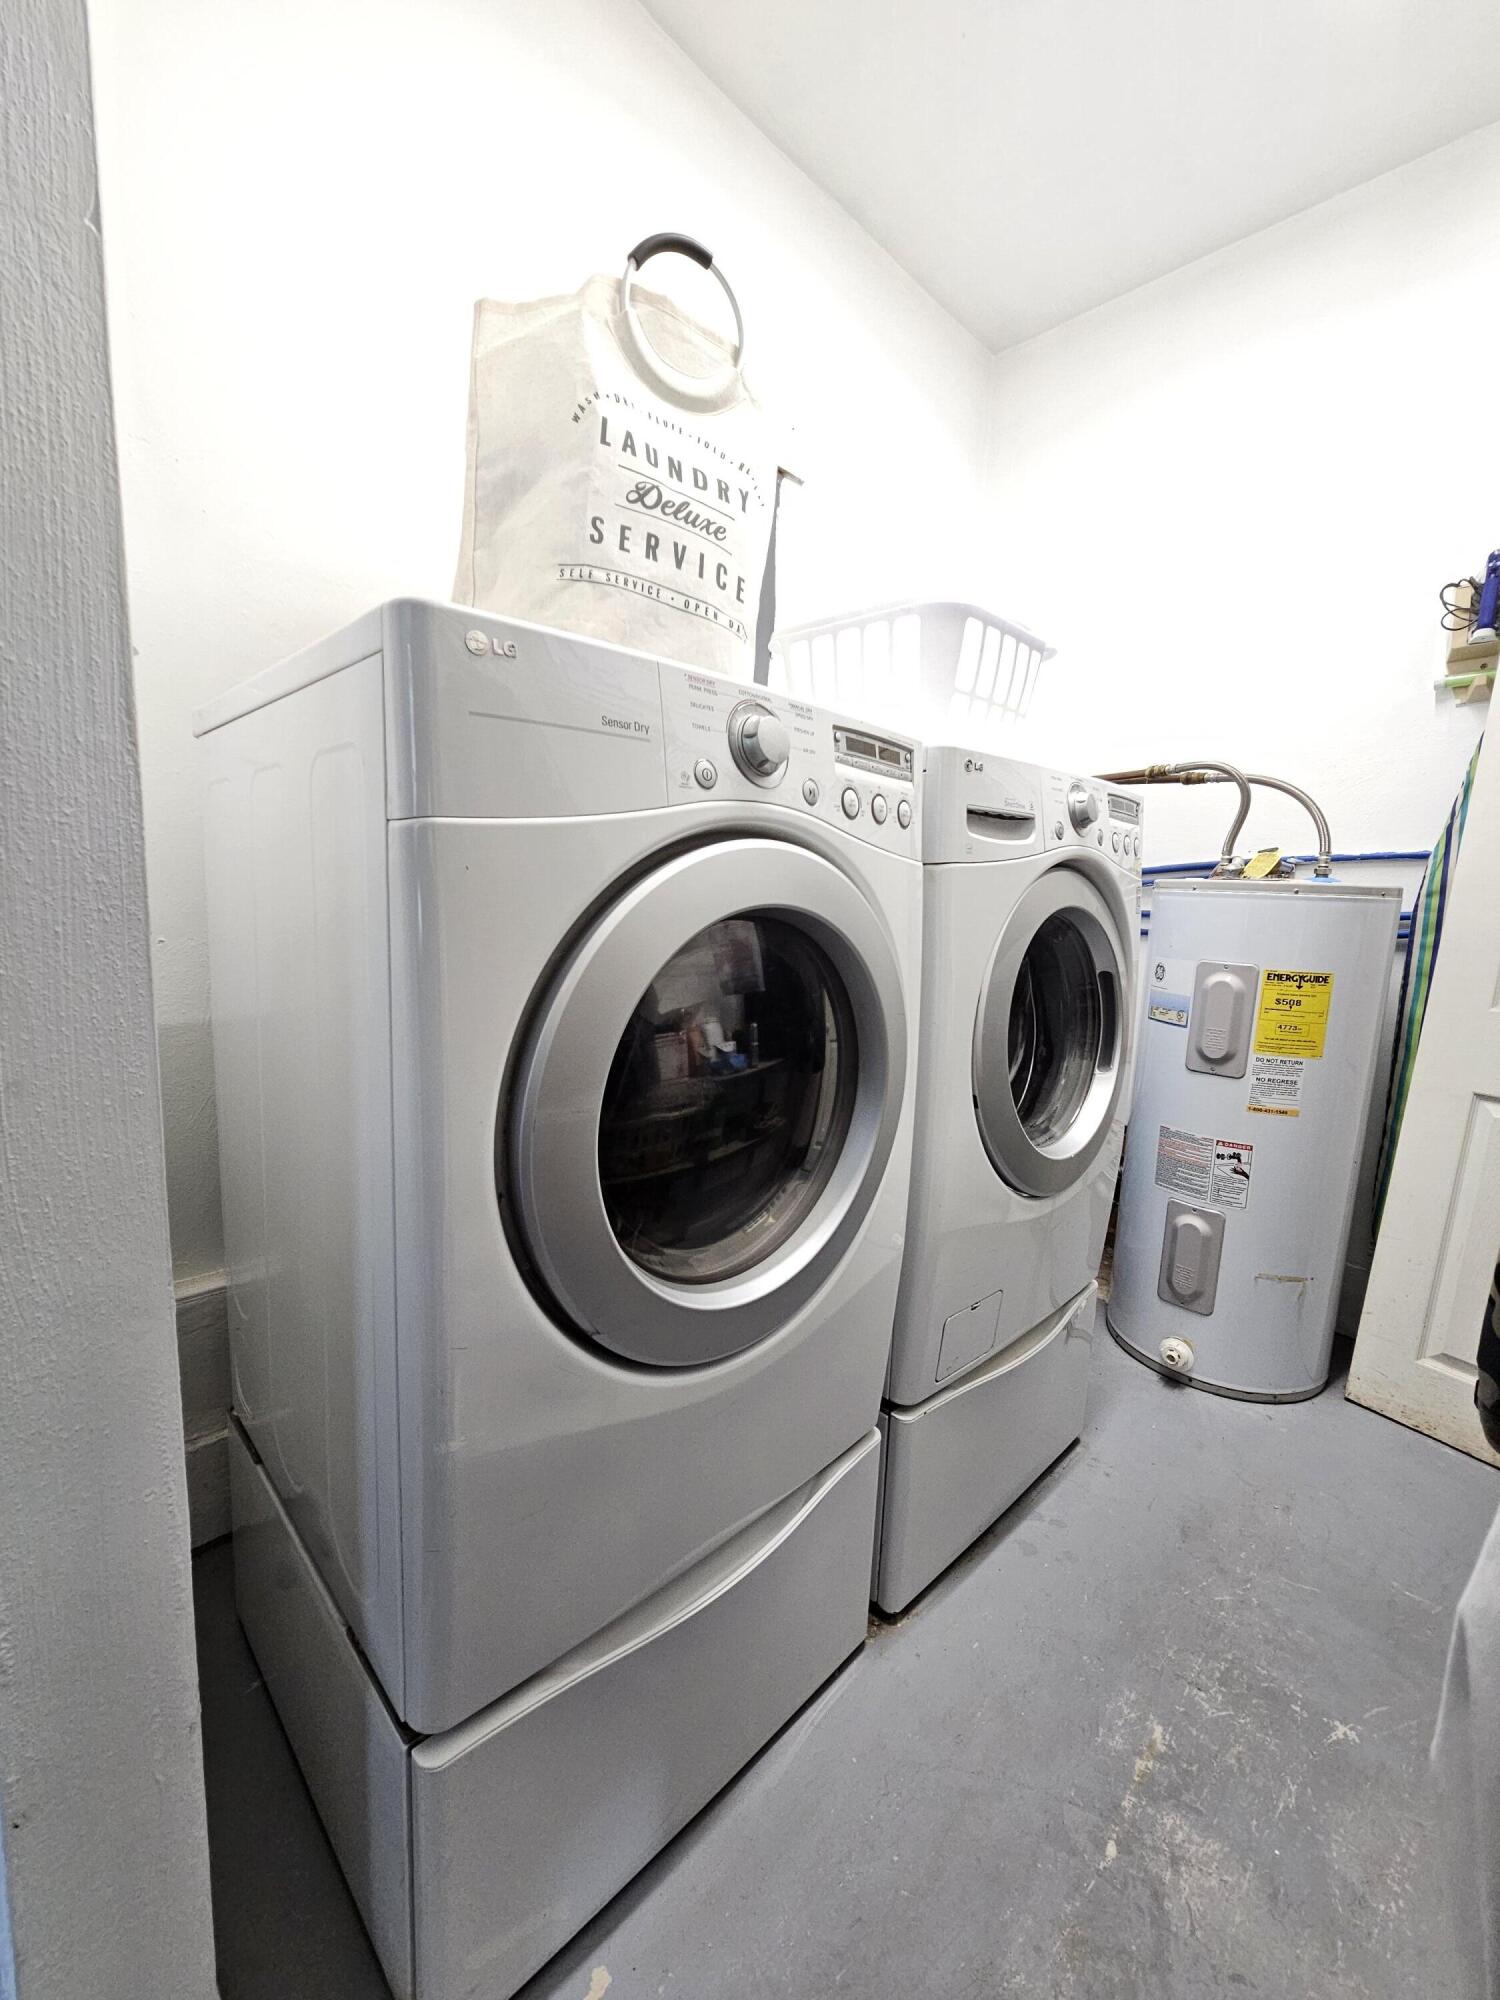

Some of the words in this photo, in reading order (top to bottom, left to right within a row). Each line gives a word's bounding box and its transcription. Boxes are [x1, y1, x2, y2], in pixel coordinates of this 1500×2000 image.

[571, 391, 600, 423] WASH
[600, 415, 749, 513] LAUNDRY
[626, 481, 727, 541] Deluxe
[589, 516, 745, 604] SERVICE
[559, 568, 594, 579] SELF
[605, 573, 661, 599] SERVICE
[684, 599, 718, 621] OPEN
[492, 637, 517, 659] LG
[601, 715, 631, 731] Sensor
[634, 719, 650, 735] Dry
